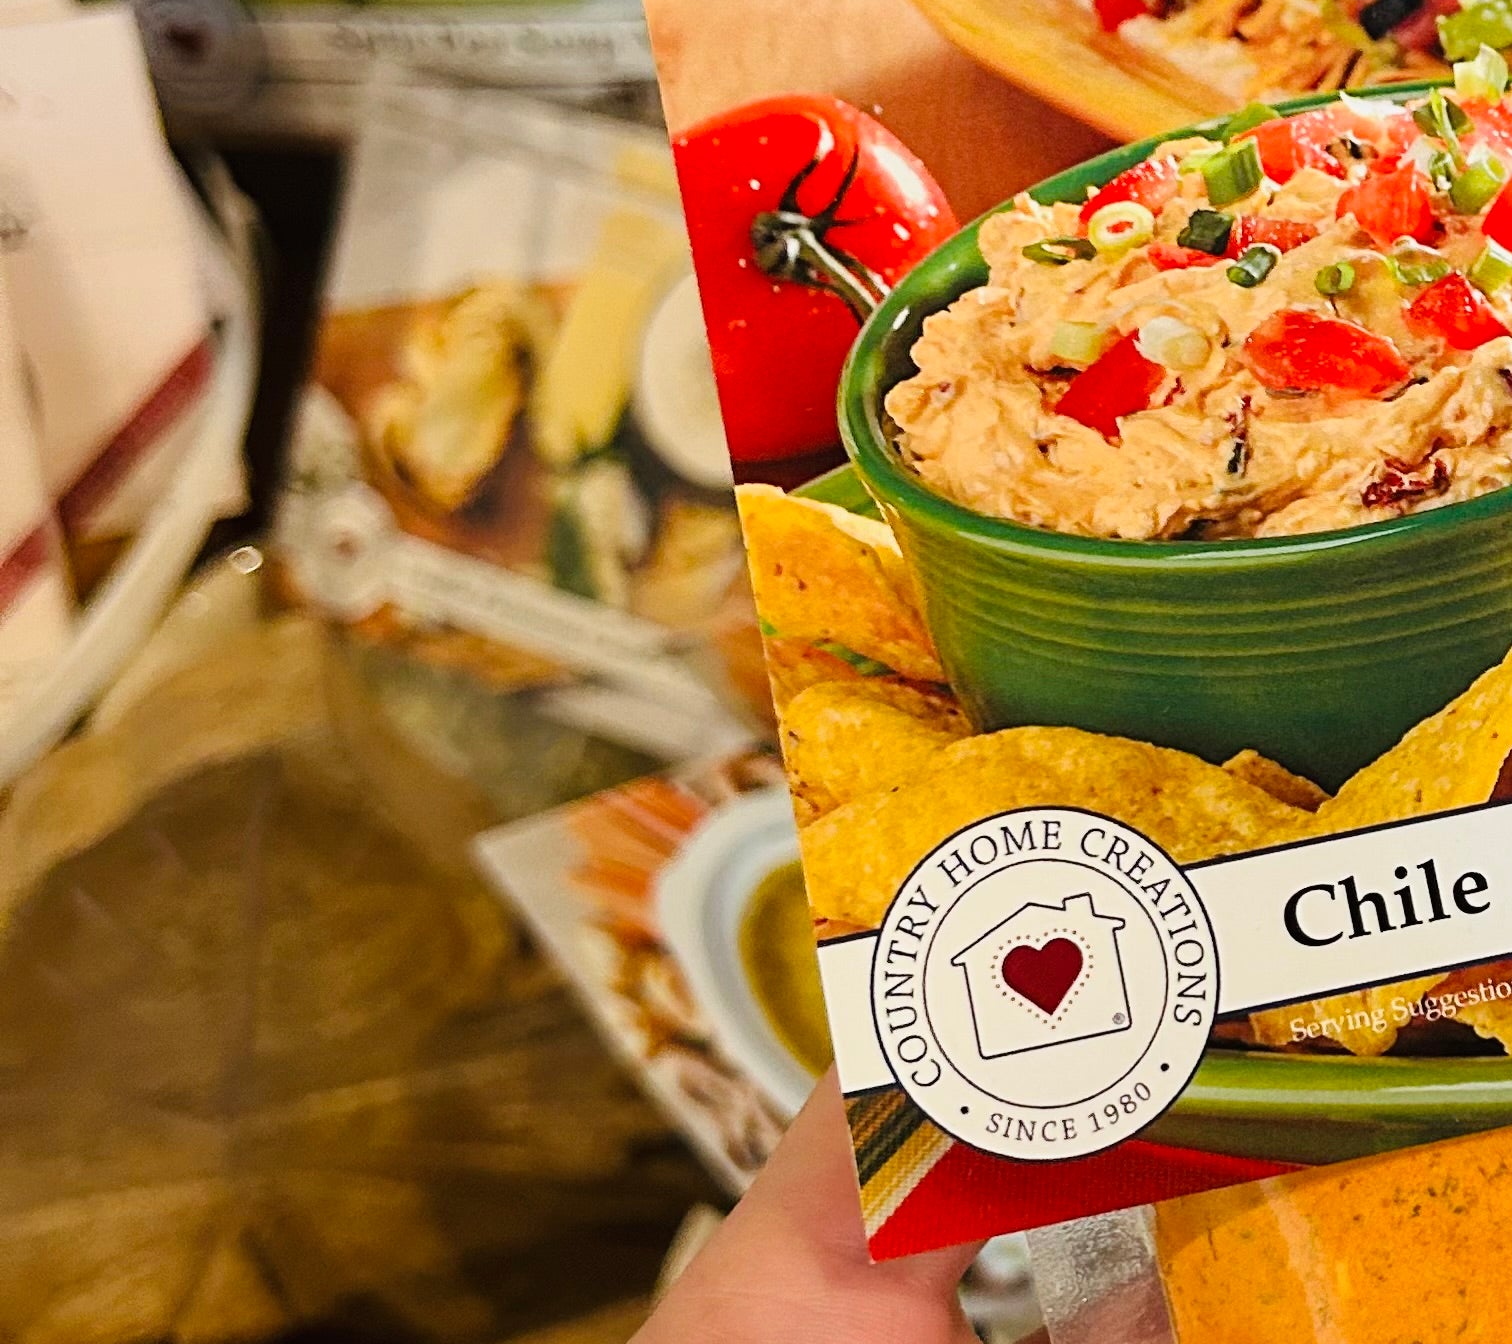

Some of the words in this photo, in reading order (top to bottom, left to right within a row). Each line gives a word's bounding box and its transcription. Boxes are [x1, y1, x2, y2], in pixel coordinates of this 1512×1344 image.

[1283, 858, 1491, 948] Chile
[884, 885, 942, 1089] COUNTRY
[937, 820, 1063, 889] HOME
[1080, 827, 1207, 1028] CREATIONS
[1289, 1002, 1388, 1044] Serving
[985, 1113, 1078, 1143] SINCE
[1088, 1081, 1152, 1134] 1980
